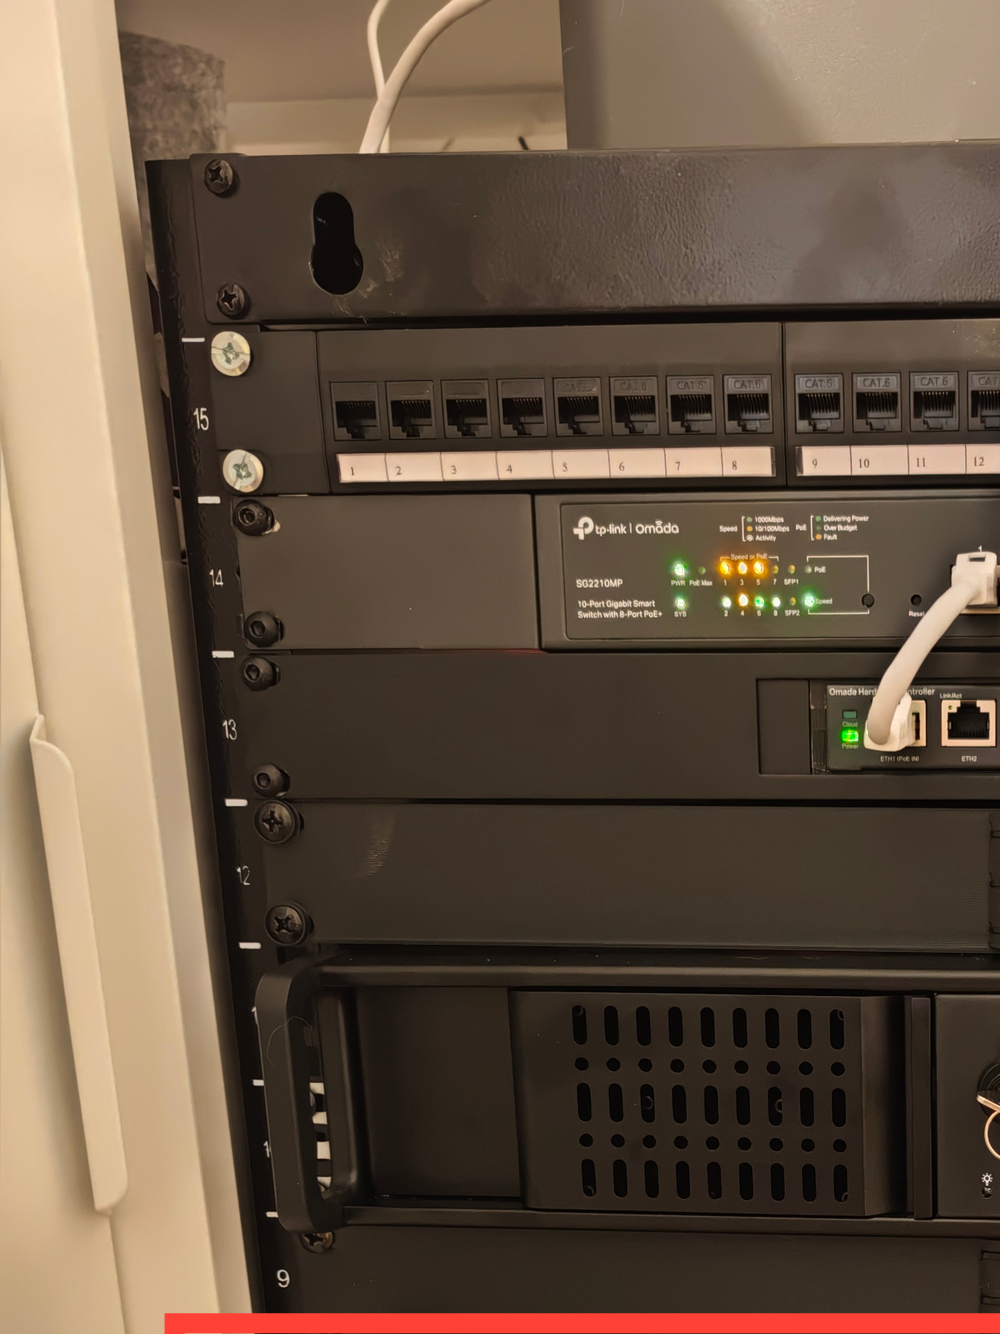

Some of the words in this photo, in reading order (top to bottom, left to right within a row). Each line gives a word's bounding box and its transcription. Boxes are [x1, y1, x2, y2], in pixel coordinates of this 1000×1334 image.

[804, 378, 833, 388] CAT.6
[862, 377, 891, 388] CAT.6
[920, 376, 949, 387] CAT.6
[192, 407, 210, 431] 15
[618, 461, 625, 471] 6
[675, 461, 681, 471] 7
[731, 461, 738, 470] 8
[812, 458, 818, 468] 9
[858, 458, 870, 468] 10
[916, 457, 926, 467] 11
[973, 456, 985, 467] 12
[350, 466, 355, 476] 1
[395, 466, 402, 475] 2
[450, 465, 457, 475] 3
[506, 464, 513, 473] 4
[562, 462, 568, 472] 5
[823, 515, 850, 523] Delivering
[719, 525, 738, 533] Speed
[755, 525, 790, 533] 10/100Mbps
[837, 524, 858, 532] Budget
[755, 534, 777, 542] Activity
[823, 533, 838, 541] Fault
[209, 569, 224, 588] 14
[576, 578, 623, 589] SG2210MP
[670, 579, 686, 587] PWR
[689, 579, 701, 587] PoE
[578, 599, 605, 608] 10-Port
[606, 599, 632, 609] Gigabit
[633, 599, 655, 608] Smart
[816, 597, 833, 605] Speed
[577, 610, 602, 619] Switch
[603, 610, 618, 618] with
[619, 610, 643, 618] 8-Port
[644, 610, 663, 618] PoE+
[829, 687, 857, 696] Omada
[858, 687, 877, 696] Hard
[907, 687, 936, 696] ntroller
[221, 720, 238, 740] 13
[235, 865, 251, 887] 12
[276, 1269, 290, 1288] 9
